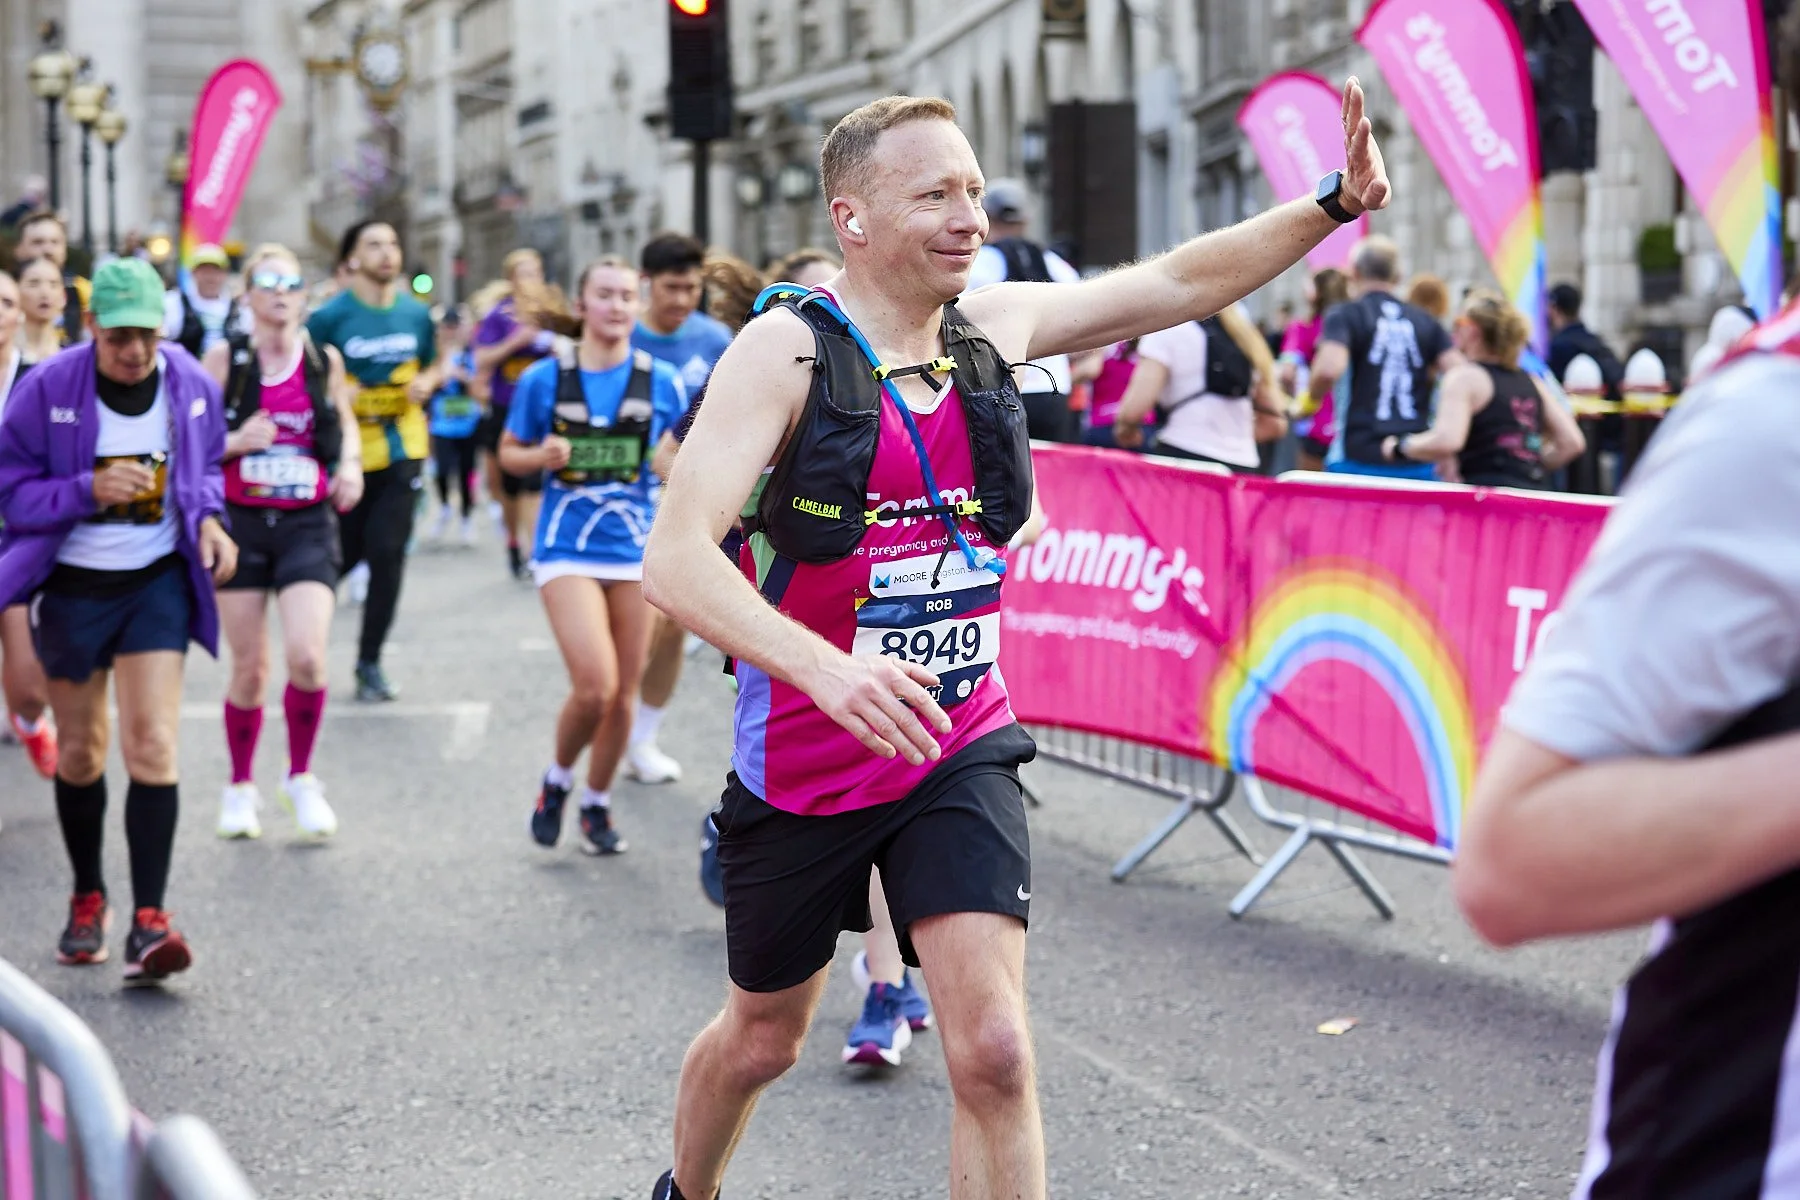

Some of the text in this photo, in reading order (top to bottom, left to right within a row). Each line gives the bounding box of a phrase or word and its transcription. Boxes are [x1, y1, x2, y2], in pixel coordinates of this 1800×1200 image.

[792, 496, 843, 519] CAMELBAK
[868, 539, 928, 559] pregnancy
[893, 571, 928, 585] MOORE
[925, 598, 953, 613] ROB
[879, 621, 981, 668] 8949
